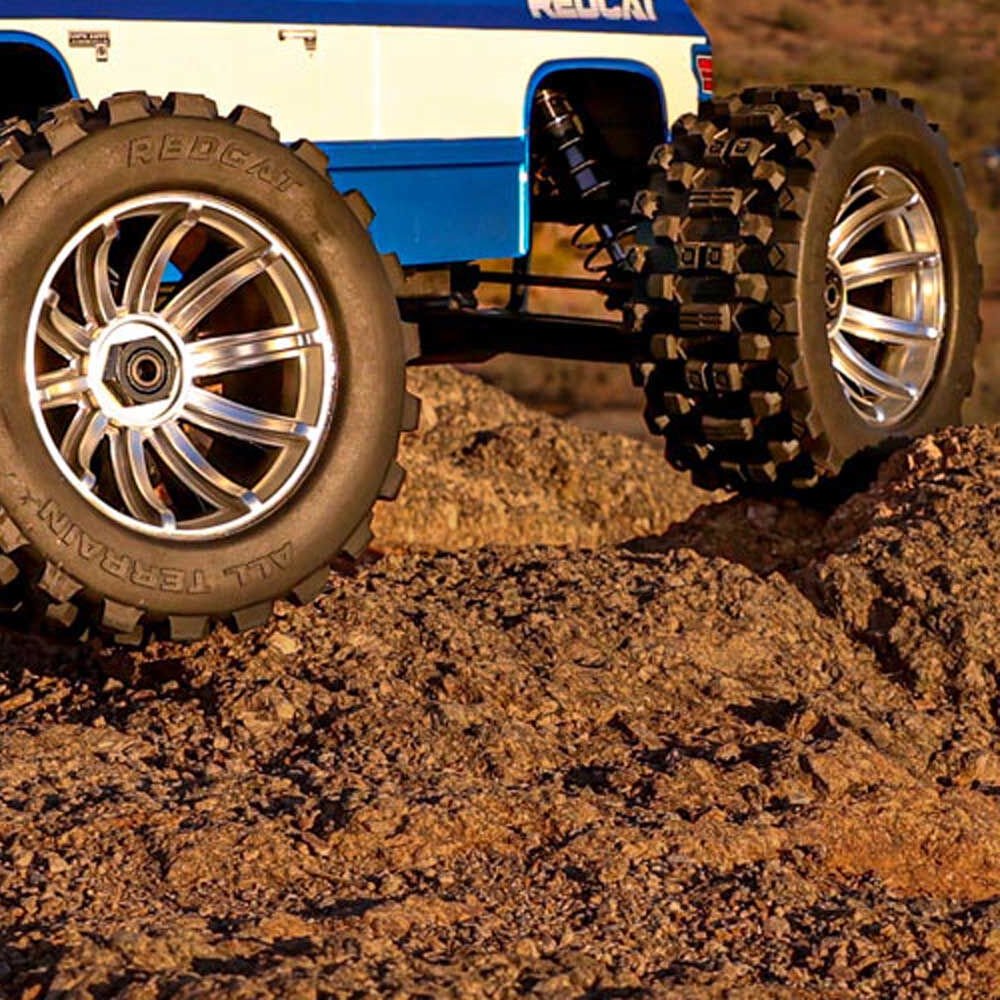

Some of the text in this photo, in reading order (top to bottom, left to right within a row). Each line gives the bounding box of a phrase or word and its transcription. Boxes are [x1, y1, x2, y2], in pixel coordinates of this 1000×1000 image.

[127, 134, 303, 193] REDCAT
[37, 500, 296, 595] ALL TERRAIN
